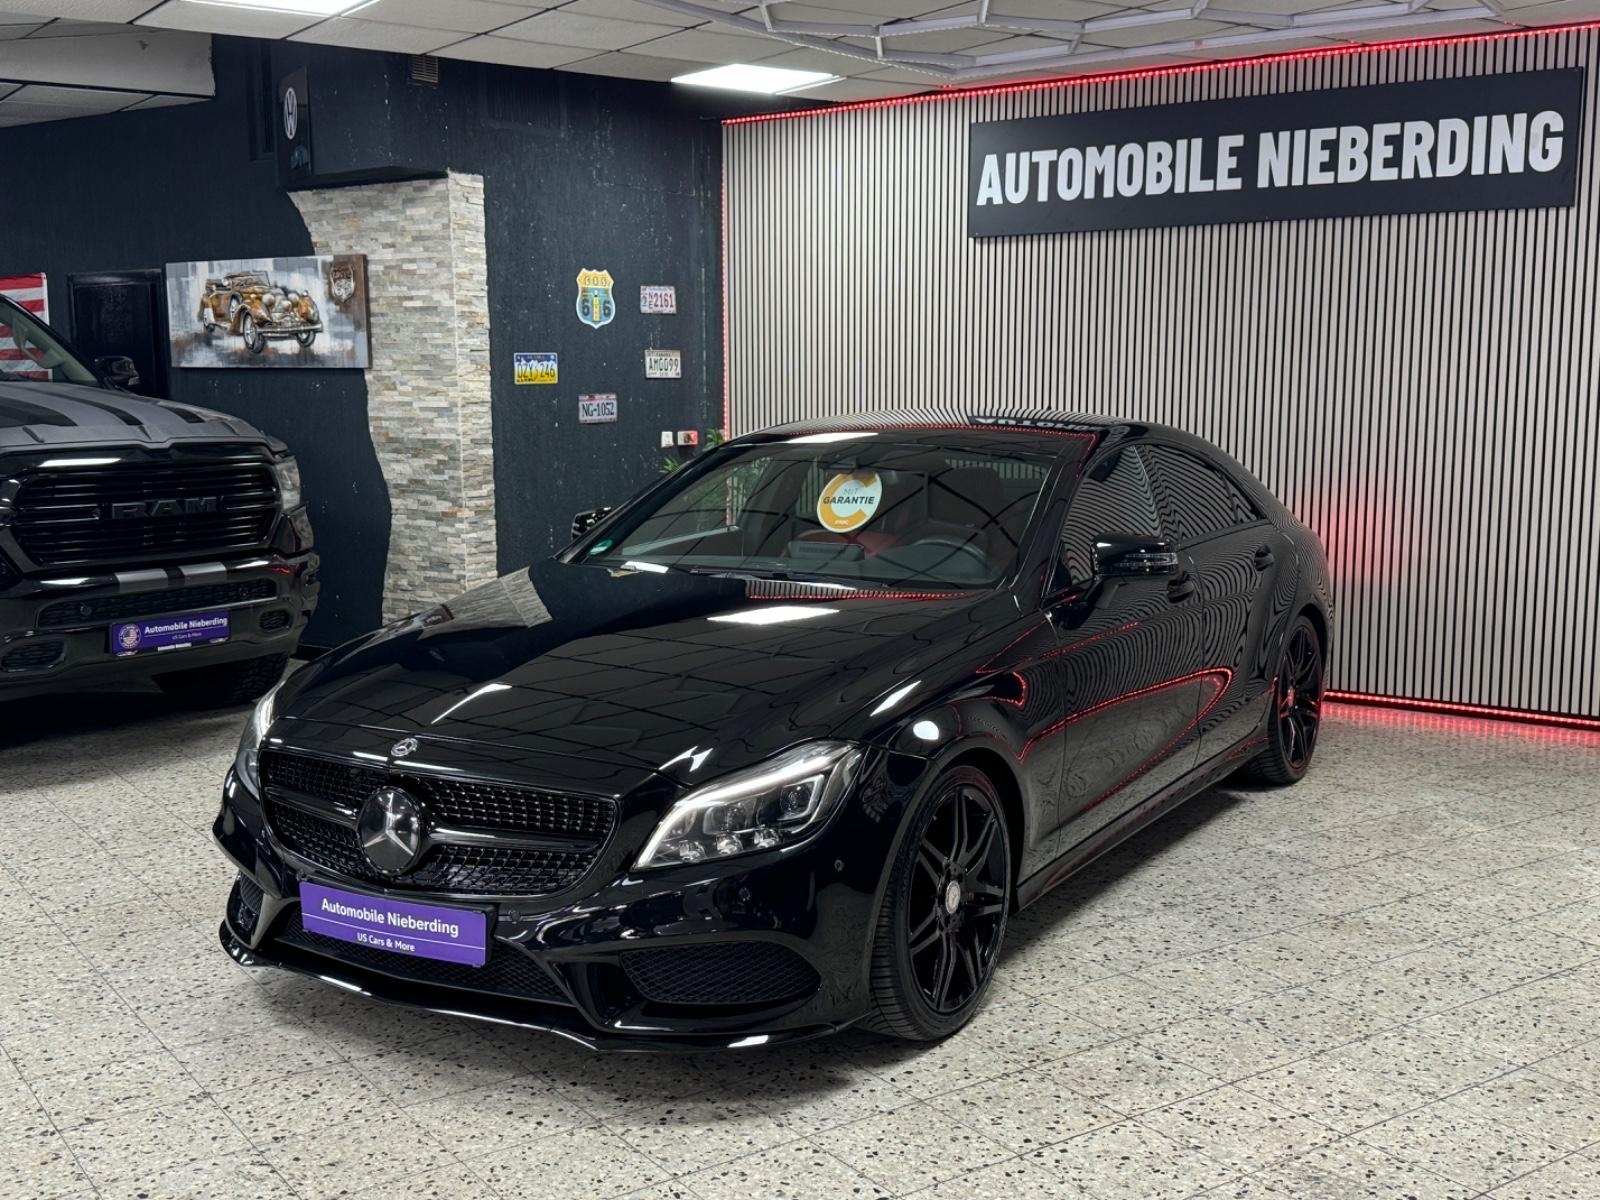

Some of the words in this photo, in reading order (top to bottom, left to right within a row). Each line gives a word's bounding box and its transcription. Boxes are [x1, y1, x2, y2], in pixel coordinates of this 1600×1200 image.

[976, 134, 1244, 206] AUTOMOBILE
[1257, 110, 1564, 188] NIEBERDING
[653, 292, 675, 308] 2161
[582, 401, 615, 417] NG-1052
[112, 496, 217, 520] RAM
[823, 496, 875, 505] GARANTIE
[144, 621, 188, 634] Automobile
[189, 617, 228, 628] Nieberding
[321, 898, 385, 924] Automobile
[387, 911, 459, 938] Nieberding
[357, 932, 367, 943] US
[369, 934, 385, 946] Cars
[386, 938, 392, 948] &
[395, 941, 415, 952] More
